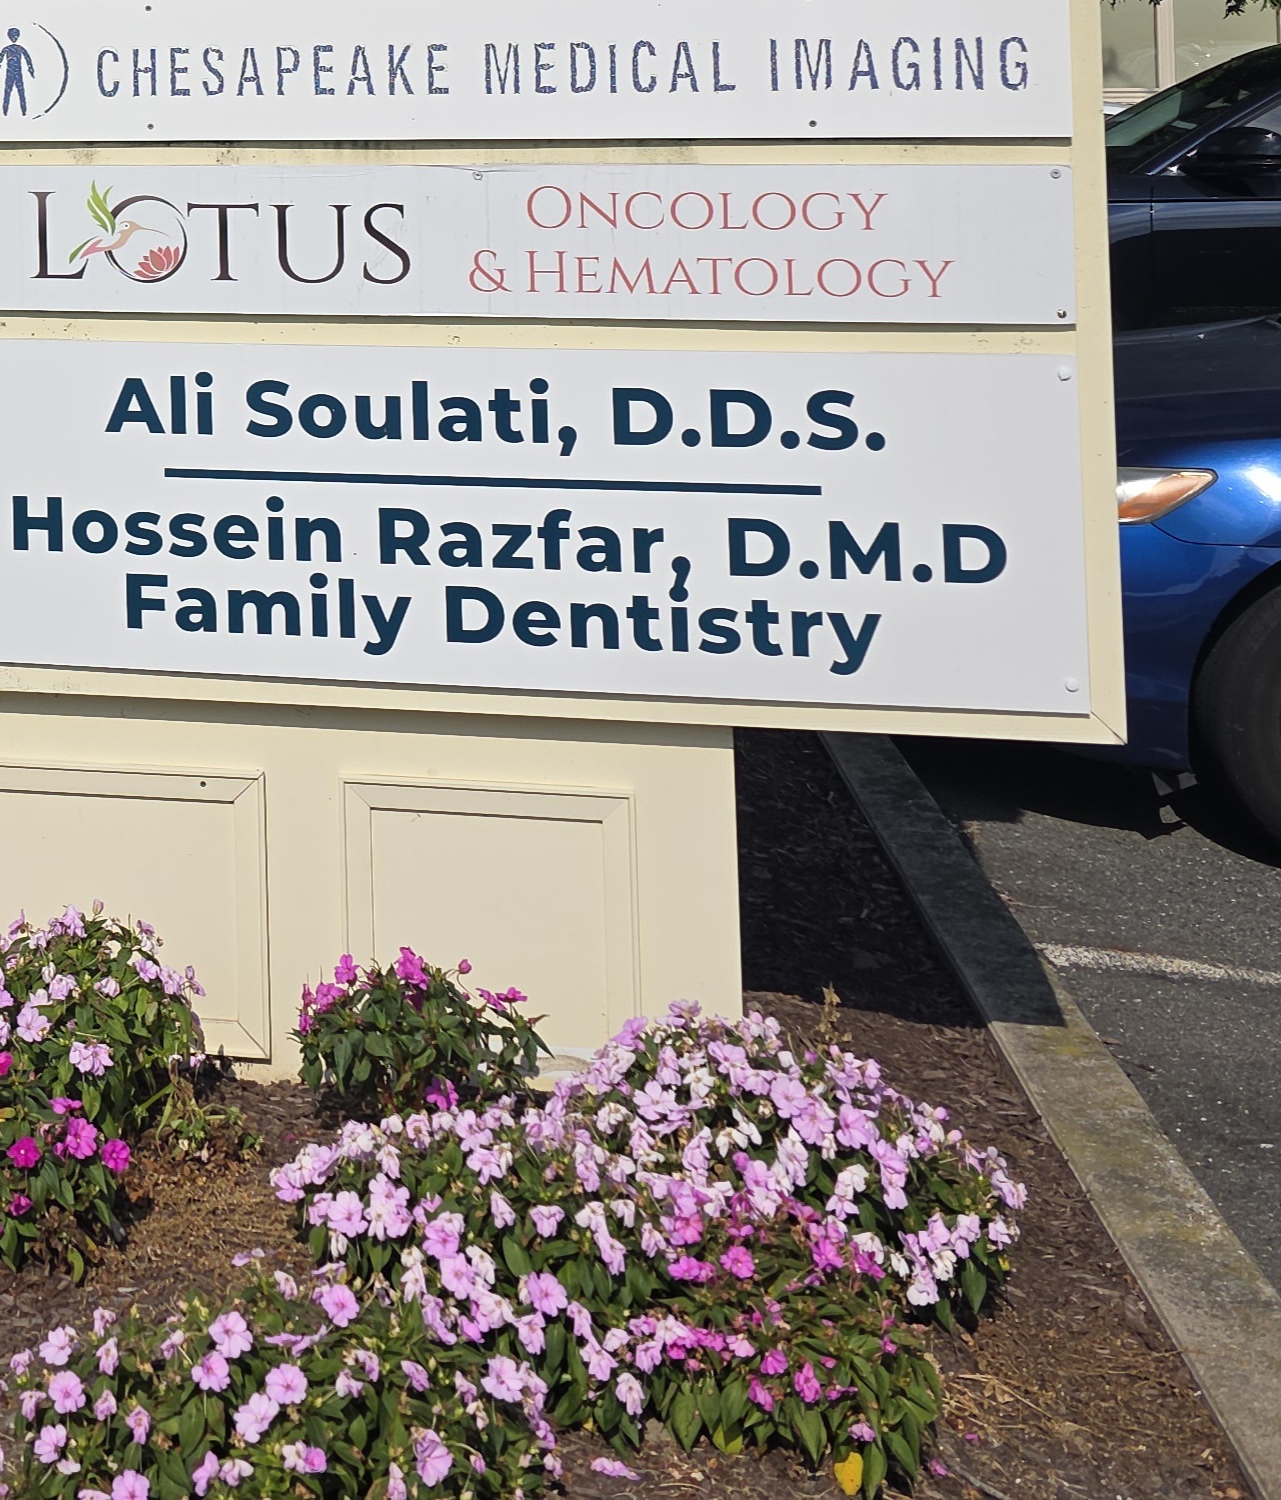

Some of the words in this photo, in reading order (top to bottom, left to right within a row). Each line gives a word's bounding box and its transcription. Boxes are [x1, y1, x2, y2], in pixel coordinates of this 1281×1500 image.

[97, 44, 449, 97] CHESAPEAKE
[485, 40, 736, 94] MEDICAL
[770, 37, 1028, 91] IMAGING
[29, 190, 410, 284] LOTUS
[527, 186, 888, 230] ONCOLOGY
[470, 250, 512, 292] &
[105, 372, 213, 435] Ali
[246, 378, 577, 456] Soulati,
[613, 388, 885, 451] D.D.S.
[13, 496, 341, 562] Hossein
[379, 508, 691, 589] Razfar,
[728, 518, 1007, 583] D.M.D
[126, 573, 412, 655] Family
[446, 585, 881, 675] Dentistry
